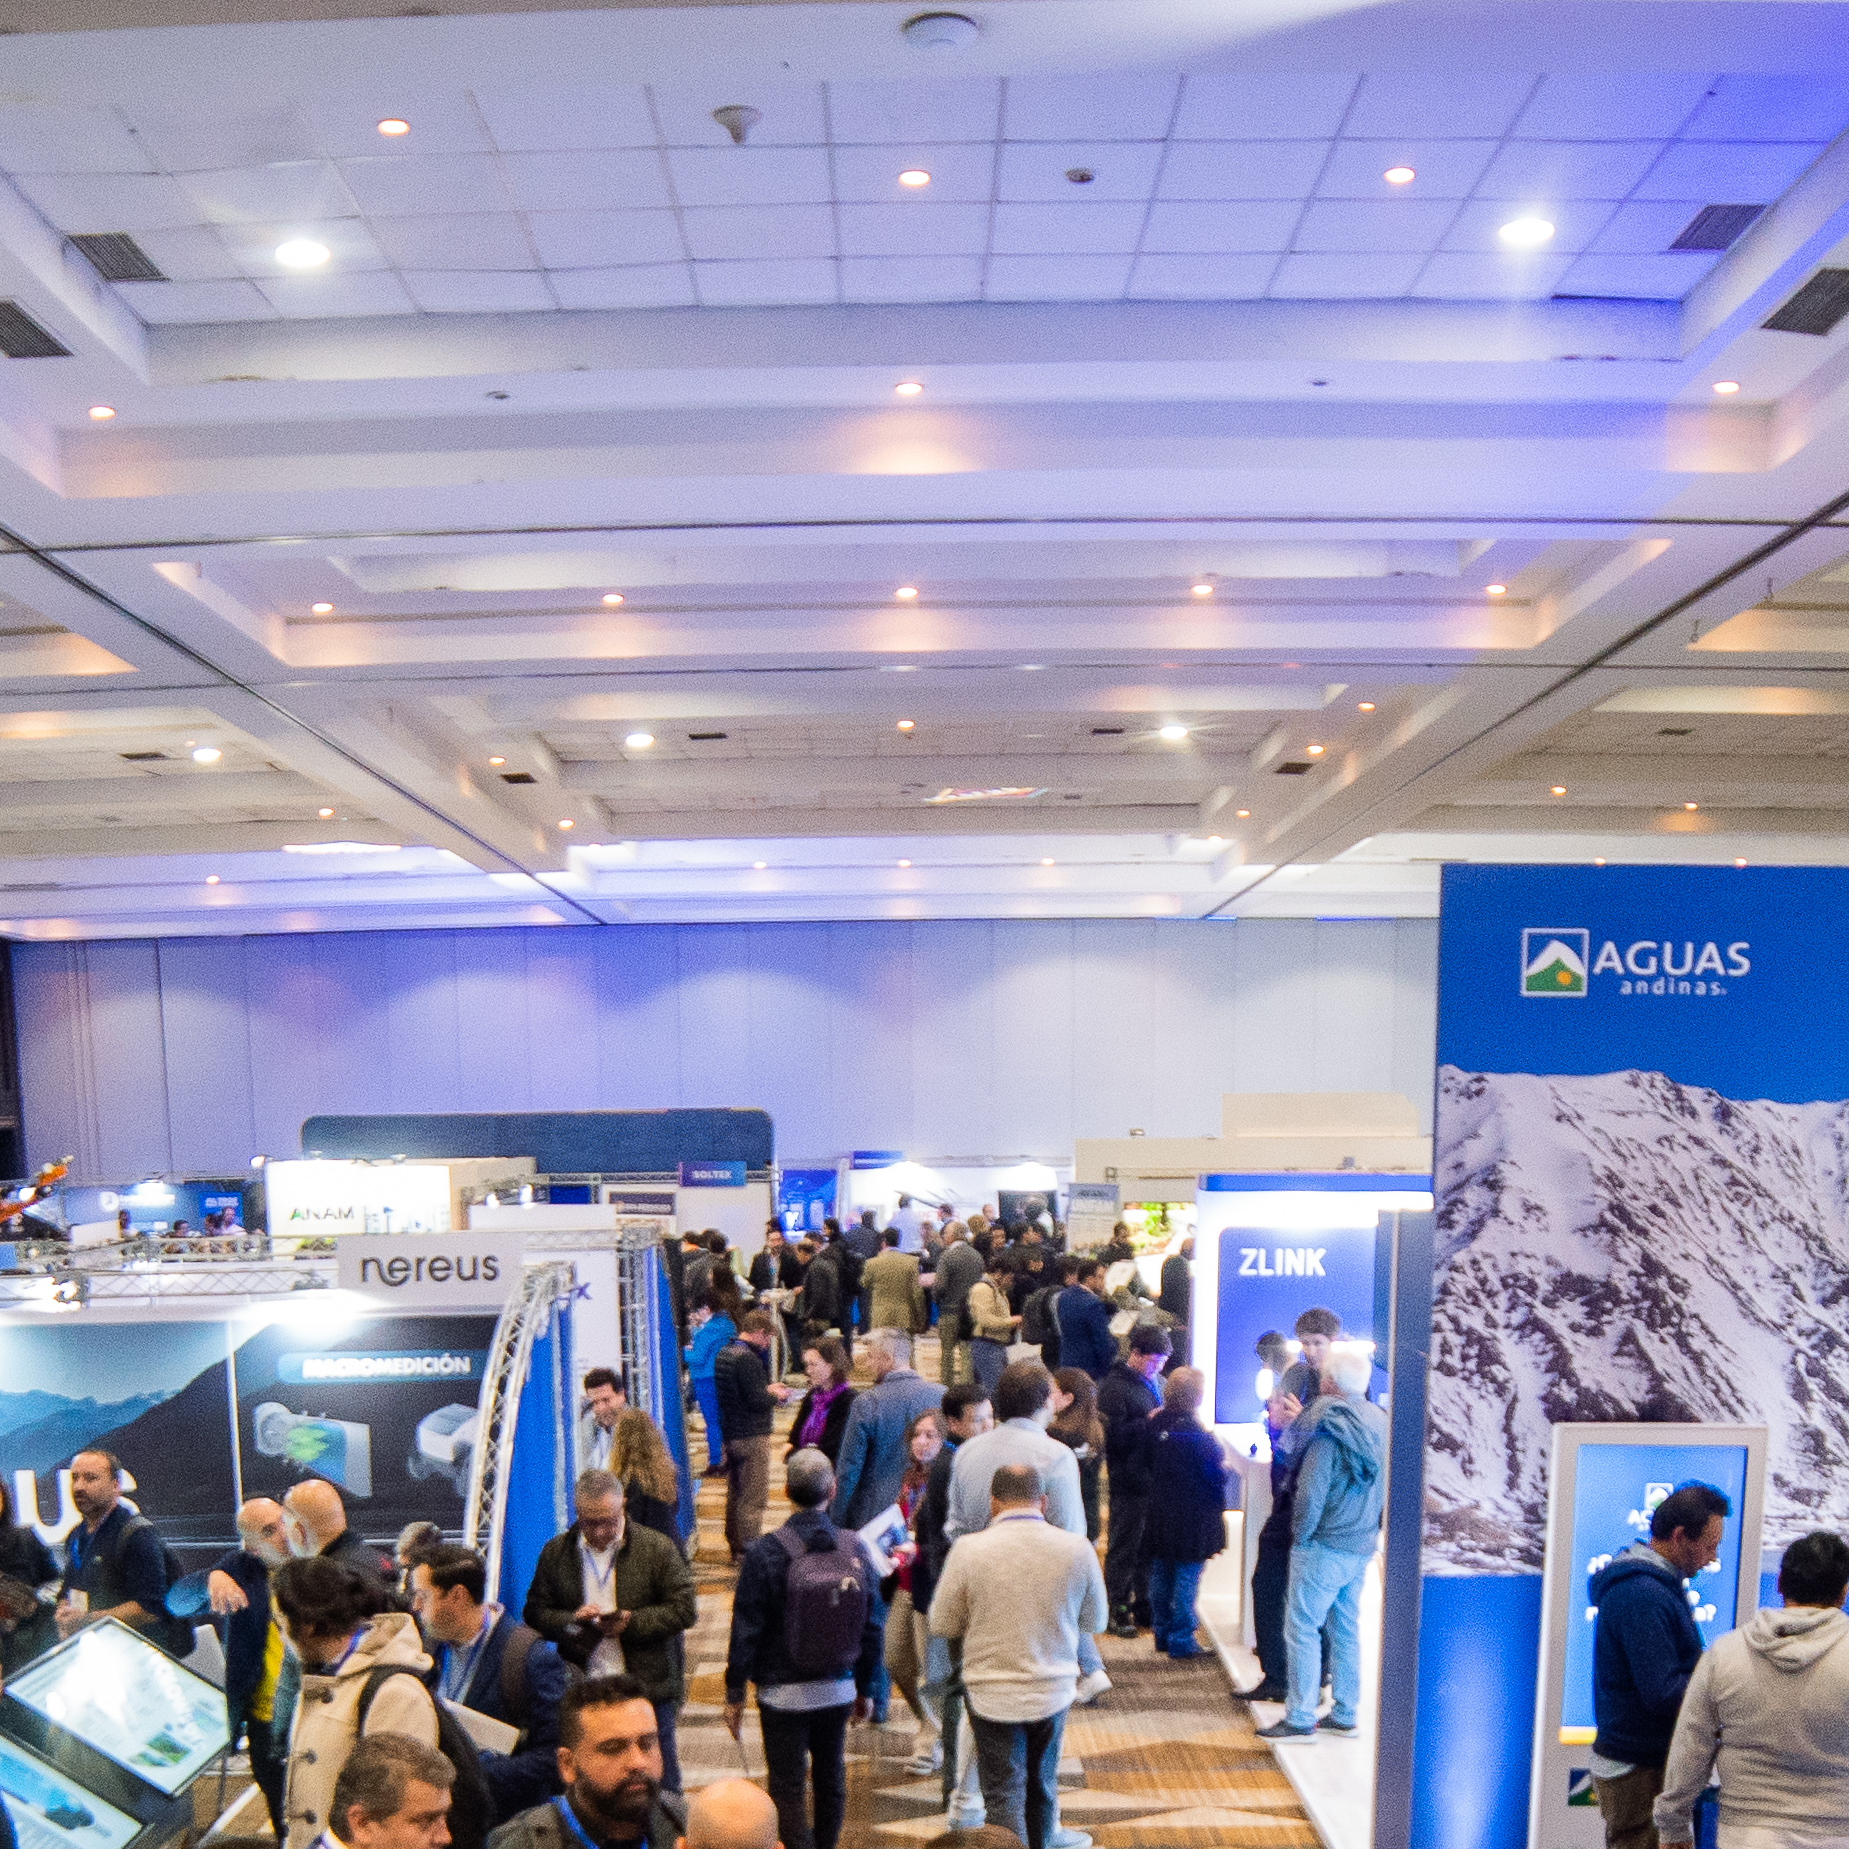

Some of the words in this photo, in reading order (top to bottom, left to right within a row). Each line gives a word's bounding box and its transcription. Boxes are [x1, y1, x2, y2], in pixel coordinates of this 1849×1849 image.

[1592, 940, 1751, 977] AGUAS
[289, 1205, 355, 1222] ANAM
[360, 1253, 500, 1287] nereus
[1238, 1247, 1327, 1277] ZLINK
